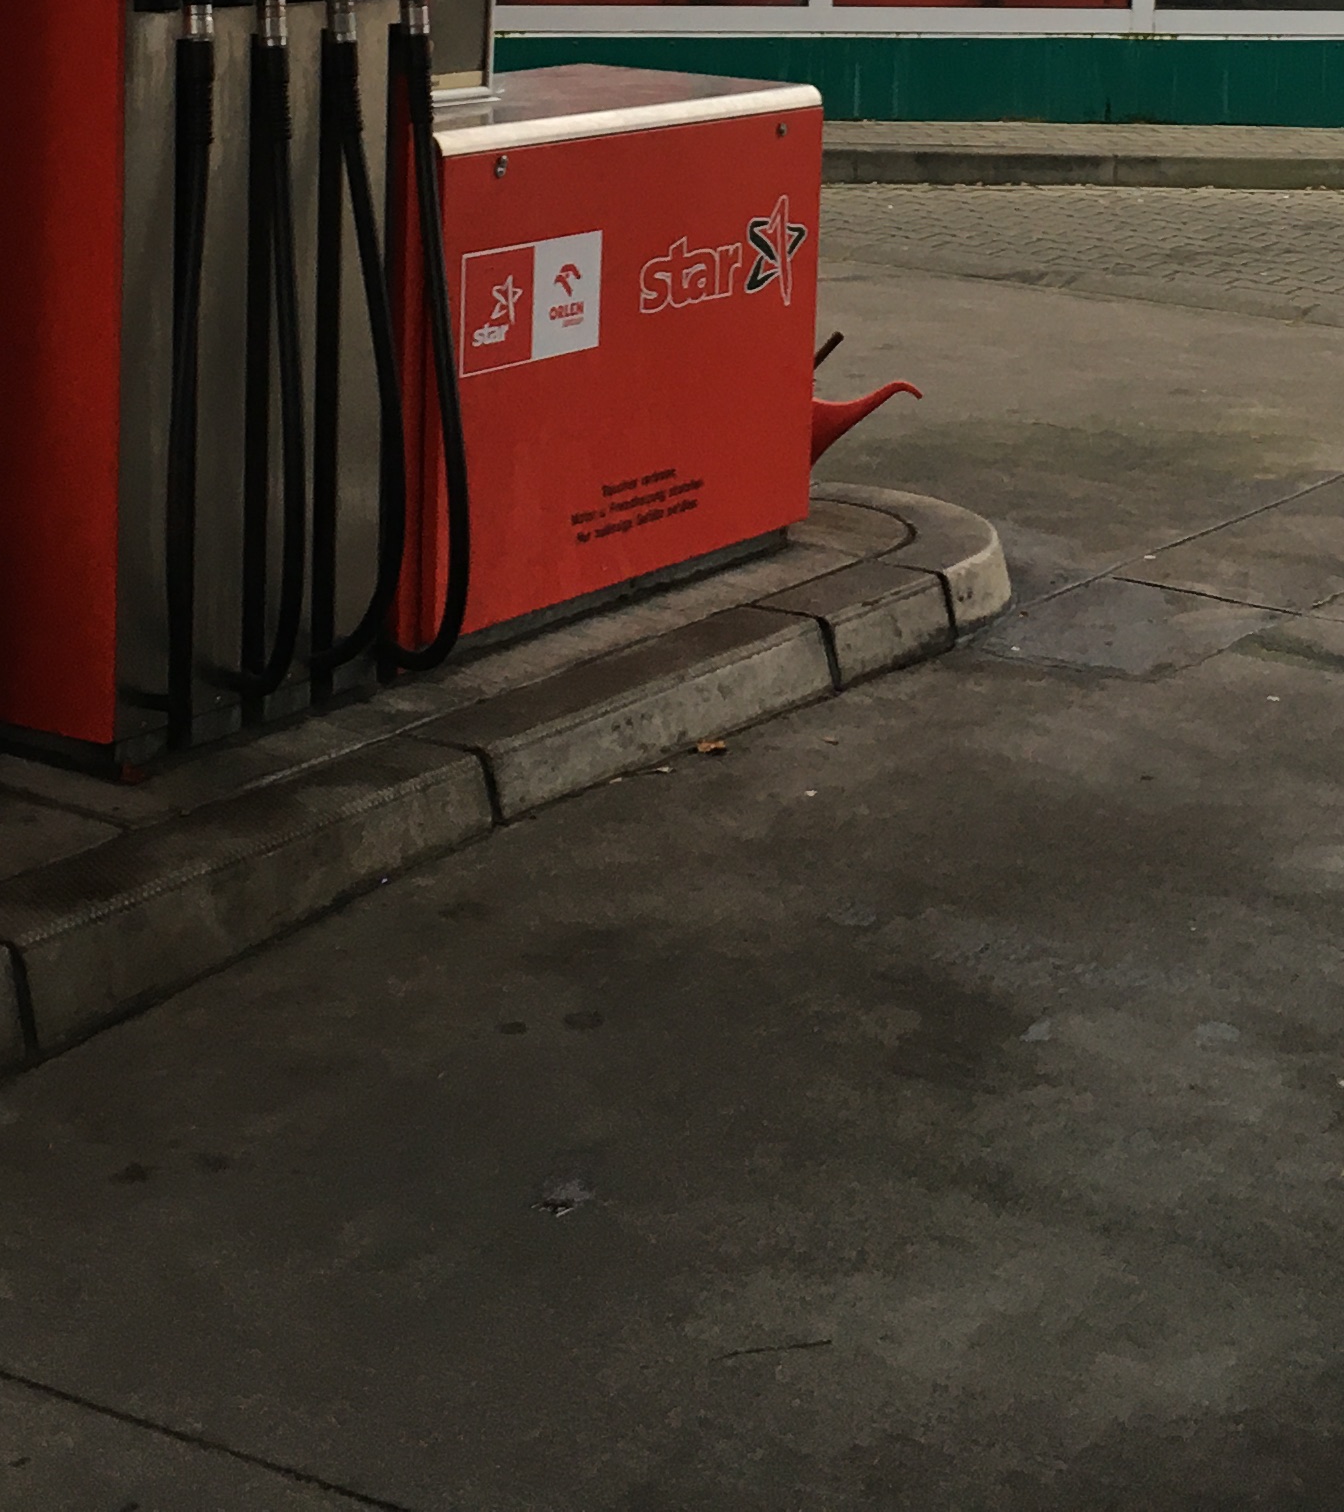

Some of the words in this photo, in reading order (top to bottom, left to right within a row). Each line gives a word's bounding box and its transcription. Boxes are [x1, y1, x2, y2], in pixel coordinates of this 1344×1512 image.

[639, 236, 743, 314] star
[548, 300, 585, 321] ORLEN
[471, 322, 510, 347] star
